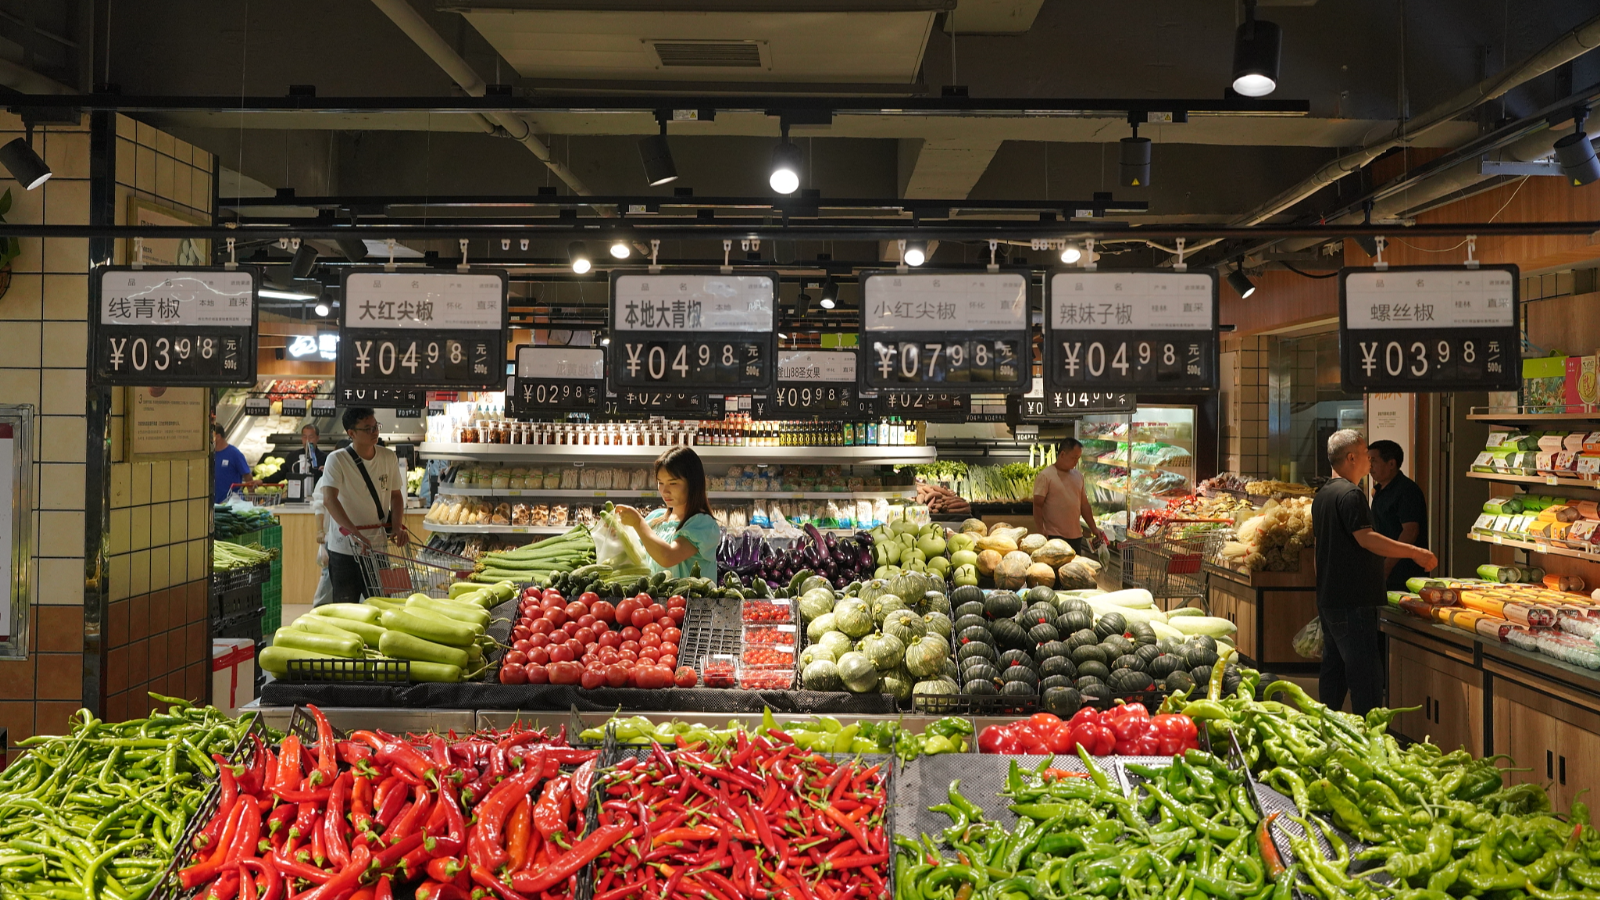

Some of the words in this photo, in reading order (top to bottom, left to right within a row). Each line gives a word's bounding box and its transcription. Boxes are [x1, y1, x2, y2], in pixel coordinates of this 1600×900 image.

[108, 297, 181, 319] 线青椒
[199, 299, 215, 307] 本地
[228, 297, 249, 307] 直采
[359, 300, 434, 321] 大红尖椒
[446, 302, 463, 310] 怀化
[476, 300, 498, 310] 直采
[715, 303, 731, 312] 本地
[873, 301, 957, 320] 小红尖椒
[969, 301, 985, 309] 怀化
[1151, 304, 1167, 312] 桂林
[1182, 302, 1204, 313] 直采
[1454, 300, 1471, 308] 桂林
[1487, 298, 1510, 308] 直采
[625, 300, 702, 329] 本地大青椒
[1060, 302, 1133, 325] 辣妹子椒
[1370, 303, 1434, 322] 螺丝椒
[110, 338, 213, 371] ¥03.98
[355, 341, 462, 375] ¥04.98
[625, 344, 734, 379] ¥04.98
[879, 343, 988, 379] ¥07.98
[1063, 342, 1175, 377] ¥04.98
[1359, 340, 1476, 377] ¥03.98
[523, 384, 583, 404] ¥02.98
[777, 387, 835, 407] ¥09.98
